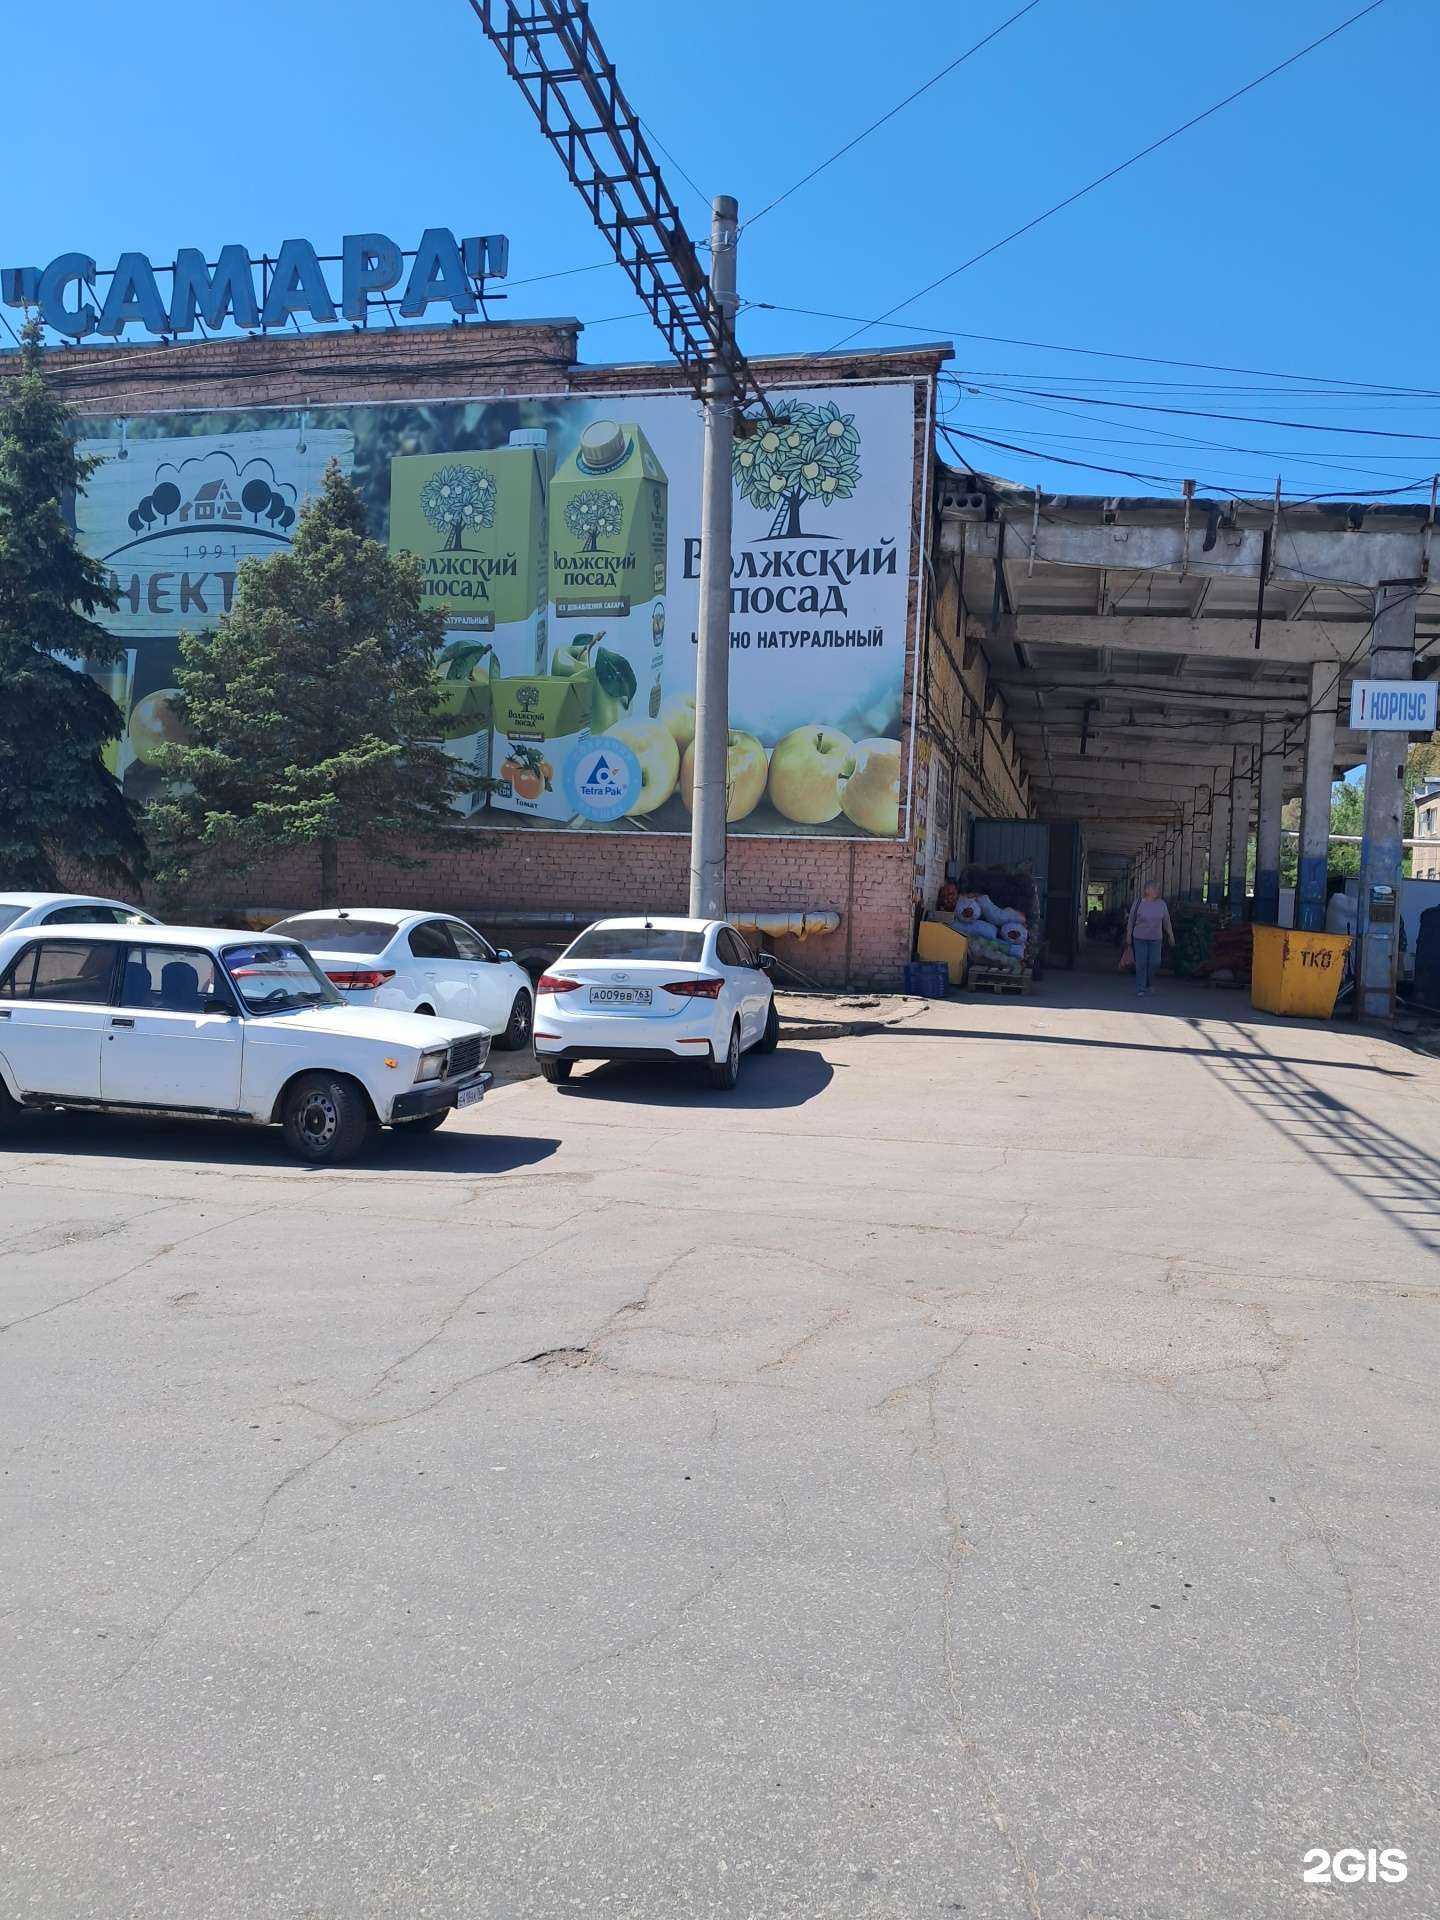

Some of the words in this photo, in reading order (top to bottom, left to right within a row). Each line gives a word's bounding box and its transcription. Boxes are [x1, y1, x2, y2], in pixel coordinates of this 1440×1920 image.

[183, 544, 237, 560] 1991
[682, 536, 897, 586] Влжский
[417, 552, 518, 581] лжский
[109, 571, 238, 615] НЕКТ
[421, 579, 490, 601] посад
[564, 572, 617, 588] посад
[730, 585, 848, 619] посад
[757, 626, 884, 650] НАТУРАЛЬНЫЙ
[1370, 692, 1427, 721] КОРПУС
[579, 785, 603, 796] Tetra
[604, 785, 622, 797] Pak
